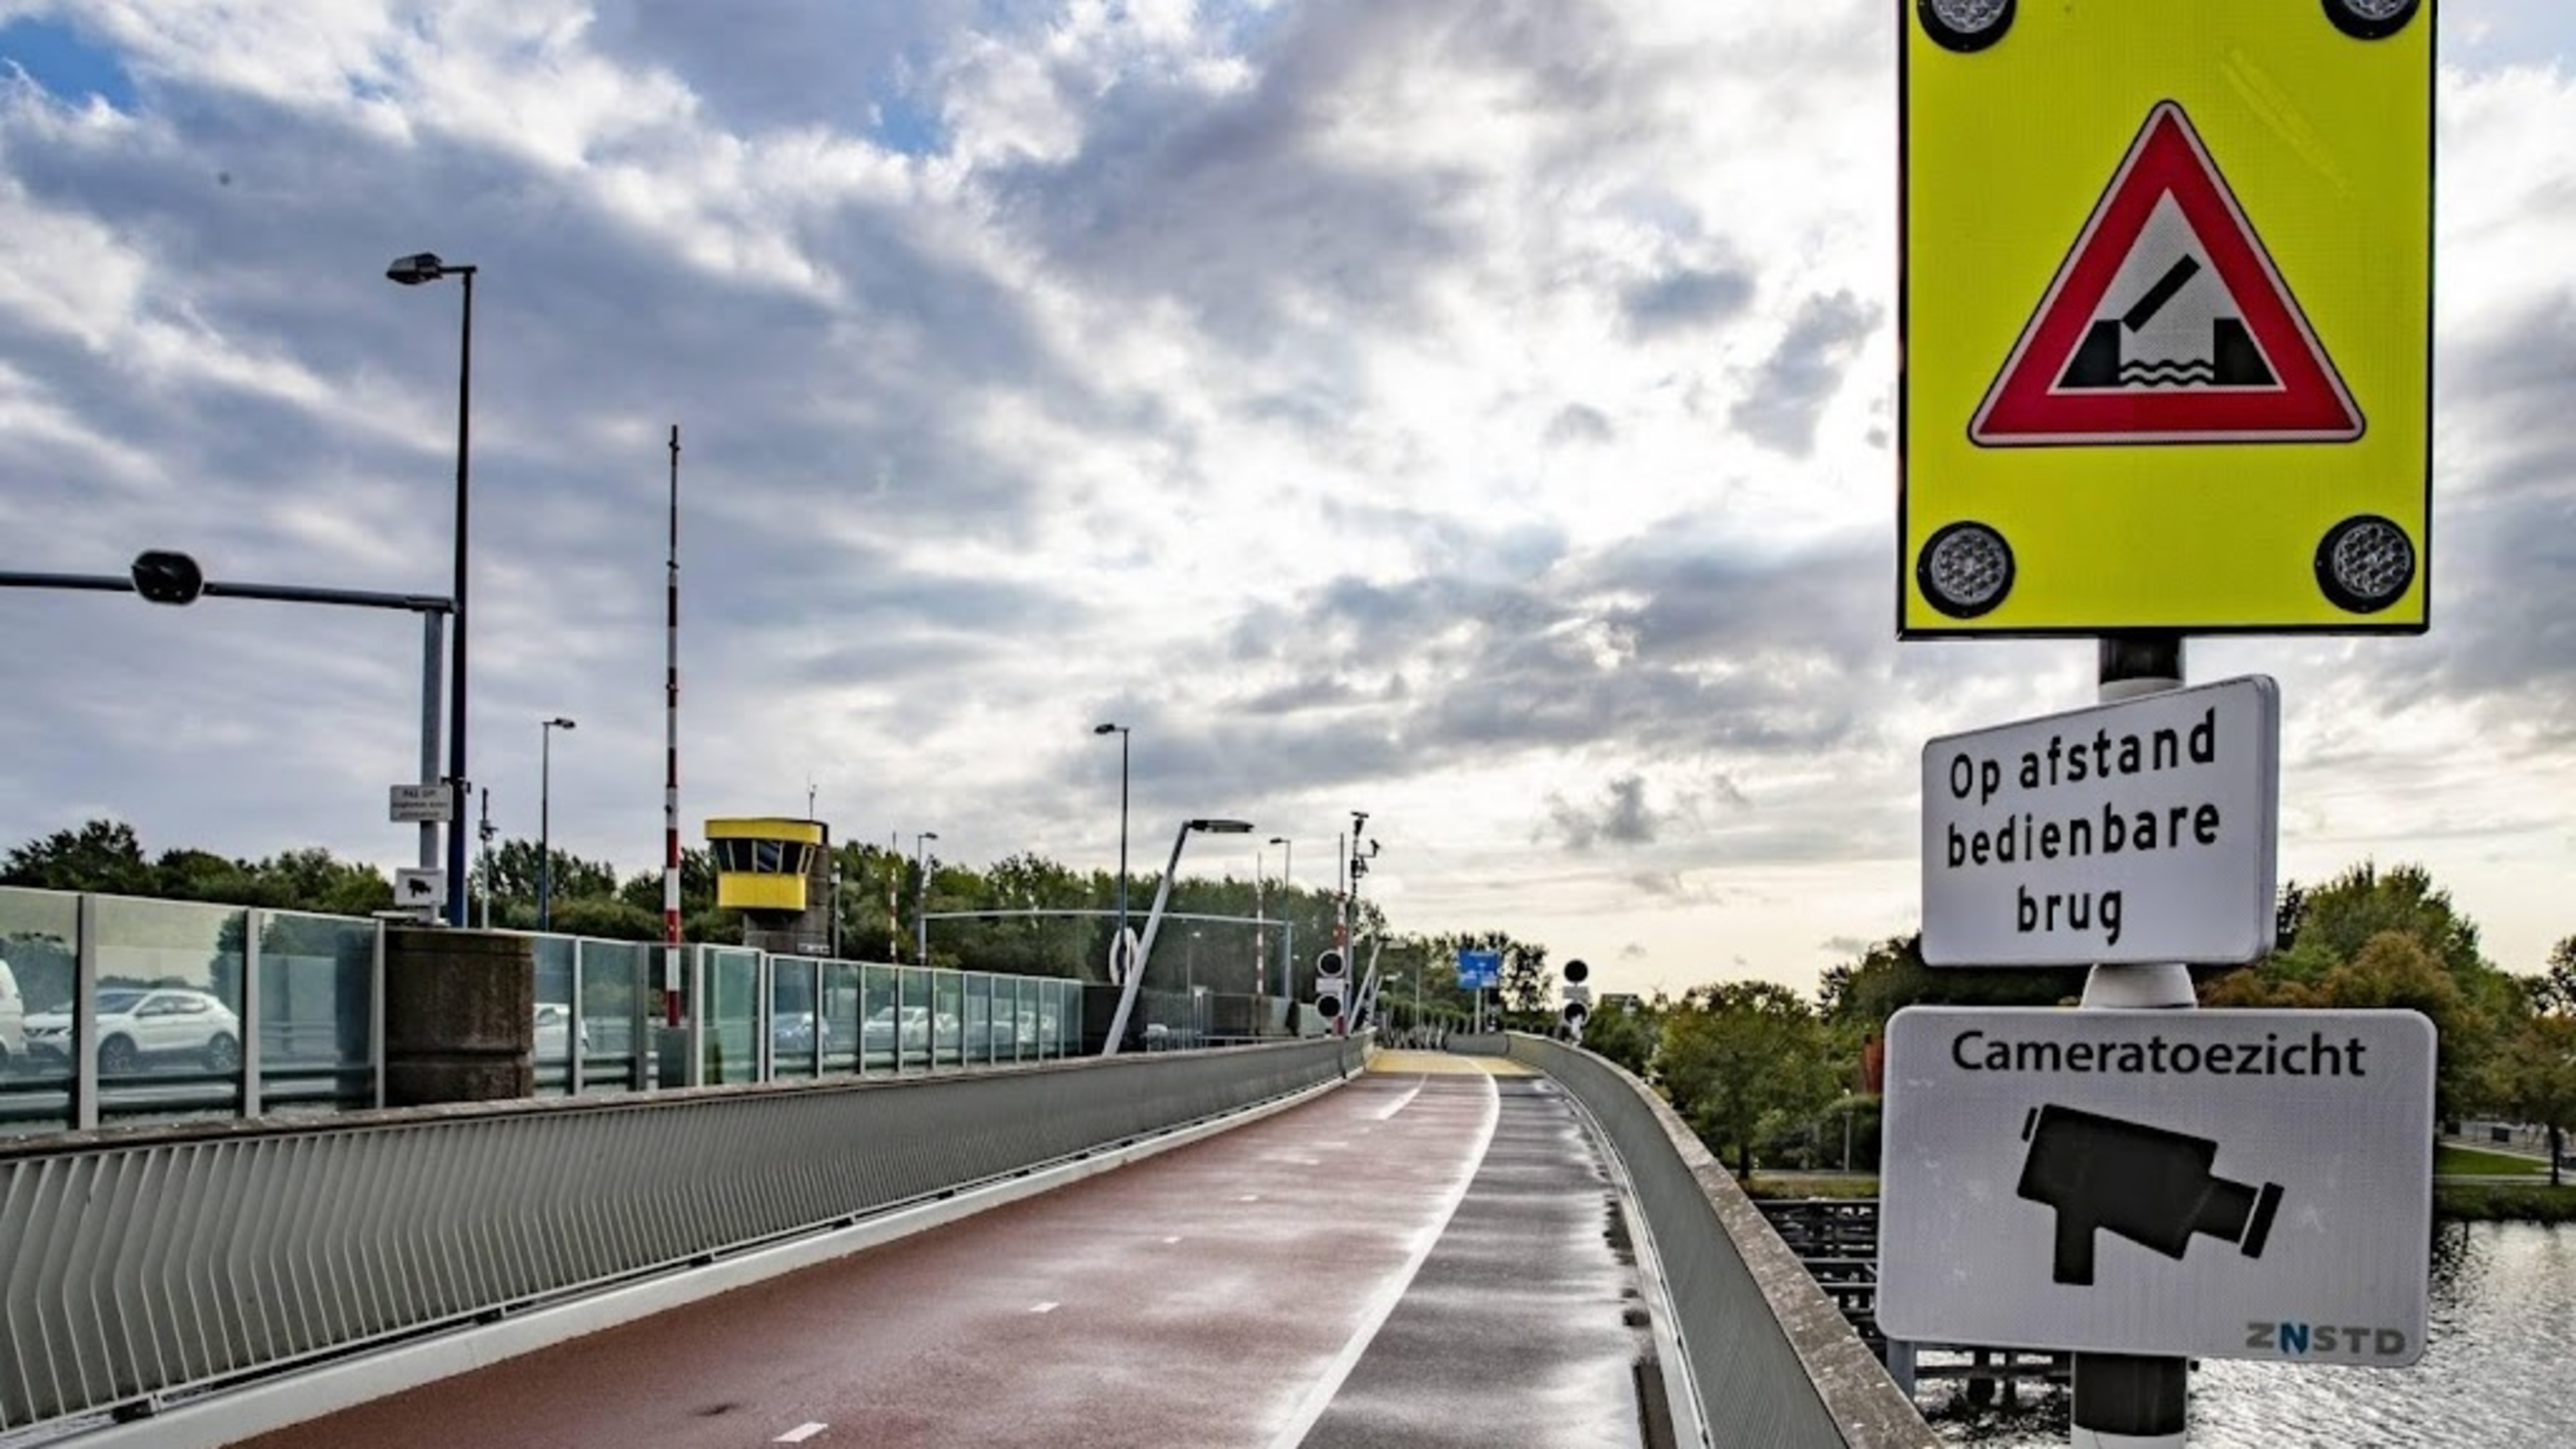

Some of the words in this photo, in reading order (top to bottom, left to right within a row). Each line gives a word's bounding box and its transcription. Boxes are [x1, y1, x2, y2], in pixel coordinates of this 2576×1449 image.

[1949, 753, 2001, 806] Op
[2019, 706, 2215, 790] afstand
[1948, 802, 2220, 869] bedienbare
[2017, 885, 2122, 947] brug
[1951, 1029, 2367, 1078] Cameratoezicht
[2245, 1322, 2406, 1356] ZNSTD
